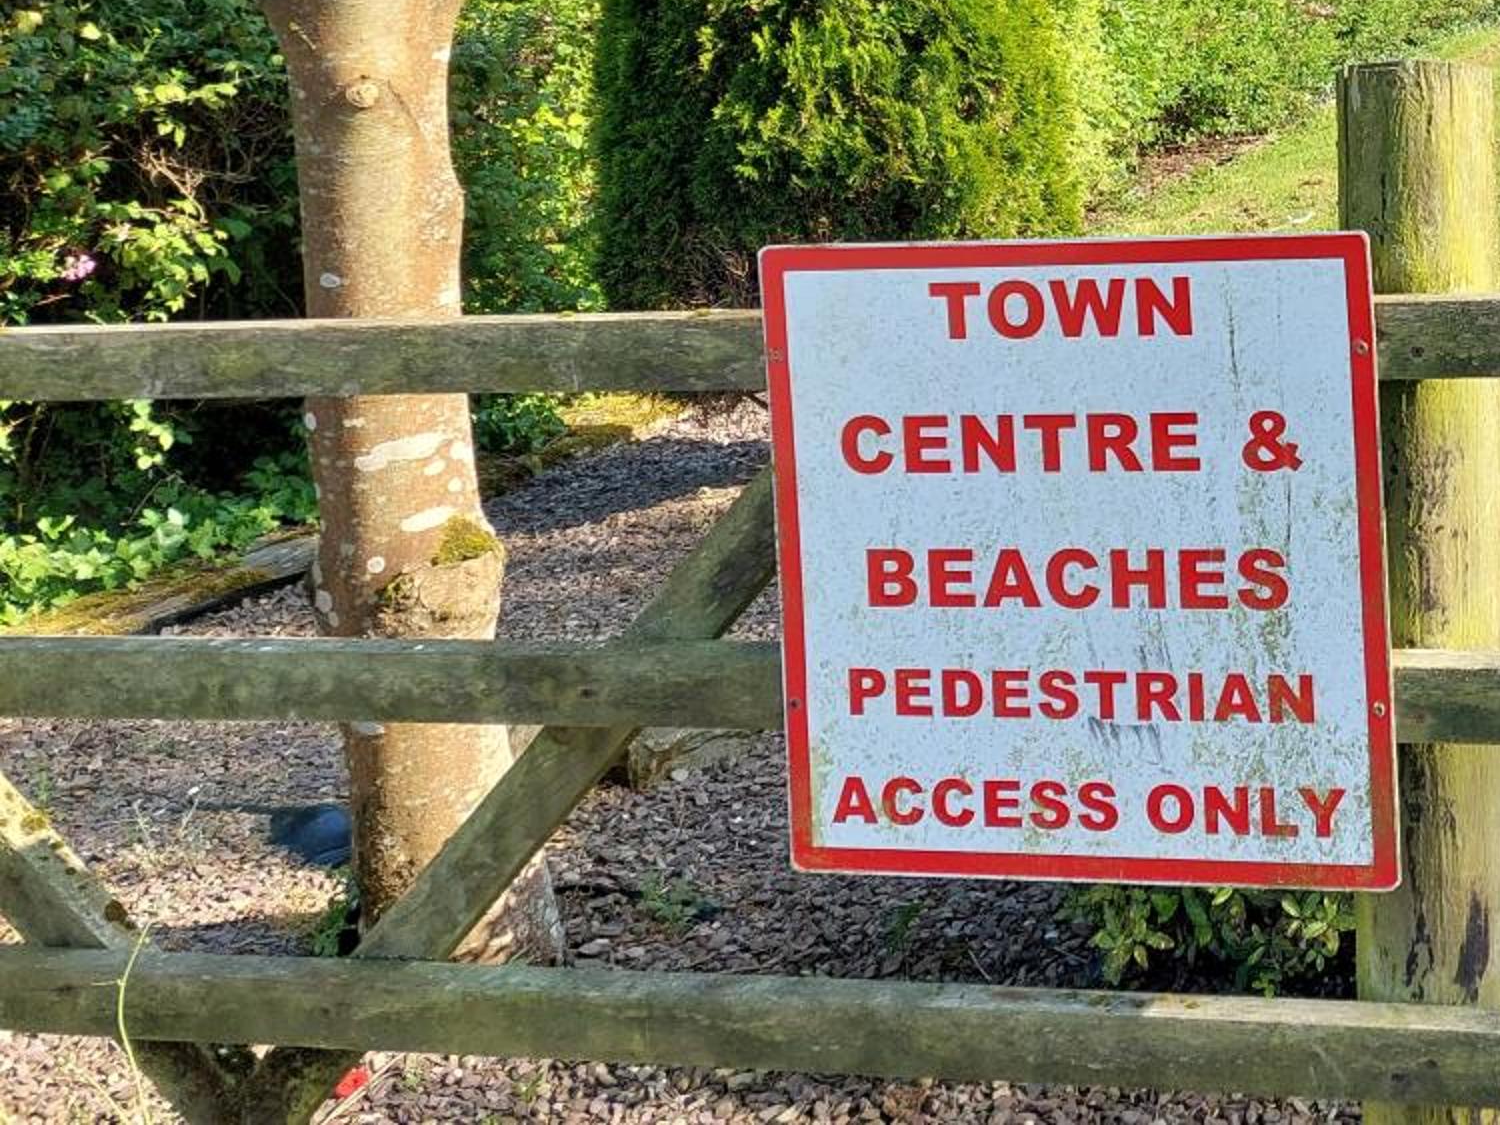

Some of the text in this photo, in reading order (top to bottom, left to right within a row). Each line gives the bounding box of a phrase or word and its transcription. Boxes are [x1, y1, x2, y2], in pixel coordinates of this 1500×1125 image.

[928, 276, 1193, 340] TOWN
[840, 410, 1302, 474] CENTRE &
[865, 548, 1289, 610] BEACHES
[848, 667, 1316, 724] PEDESTRIAN
[833, 776, 1346, 838] ACCESS ONLY
